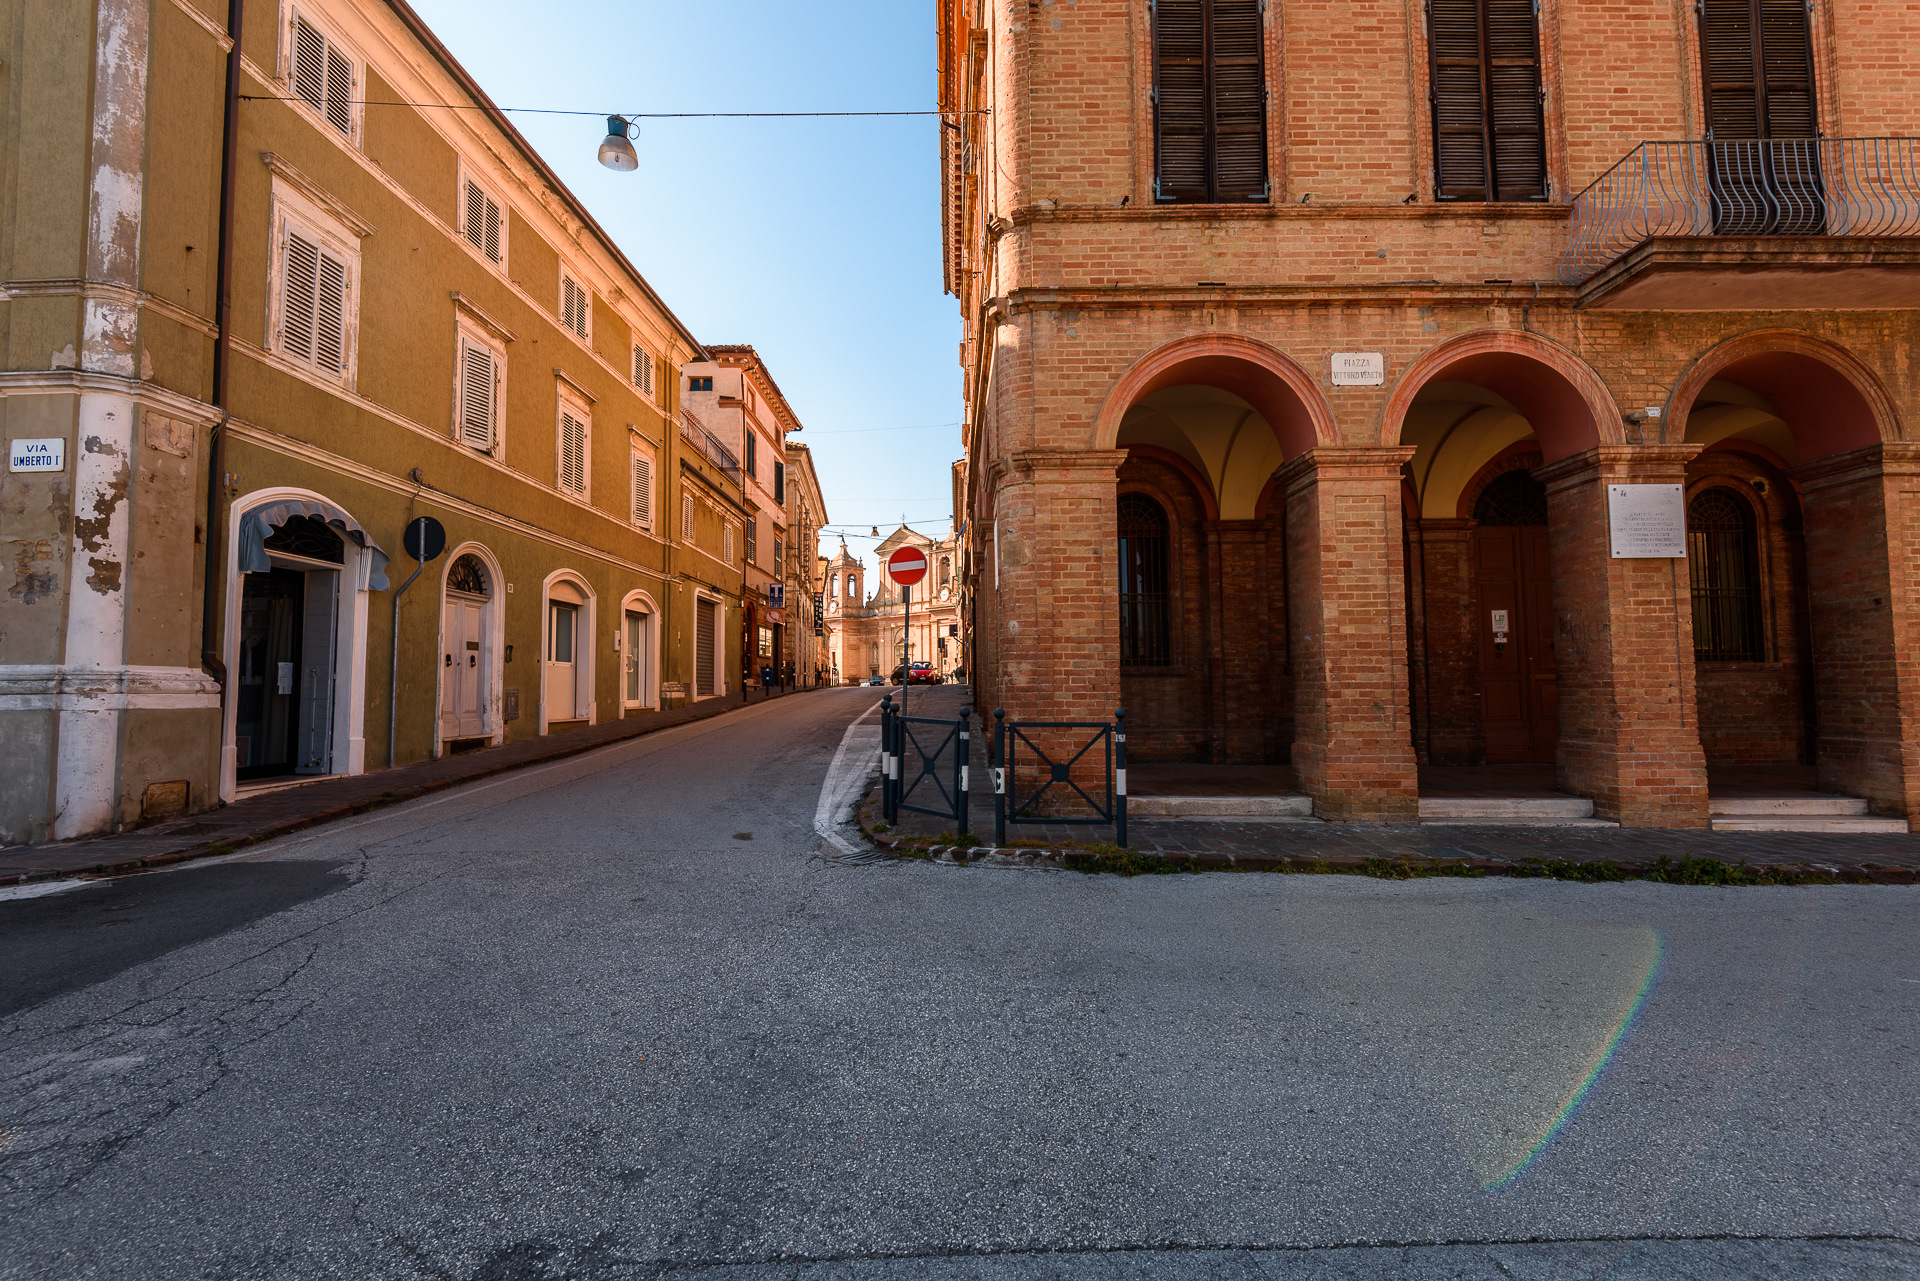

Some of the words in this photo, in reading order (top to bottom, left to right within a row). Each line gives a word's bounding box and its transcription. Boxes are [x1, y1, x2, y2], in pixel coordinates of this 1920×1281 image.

[1344, 358, 1370, 367] PIAZZA
[1360, 371, 1382, 379] VENETO
[26, 444, 48, 453] VIA
[13, 455, 52, 467] UMBERTO
[771, 584, 782, 598] T
